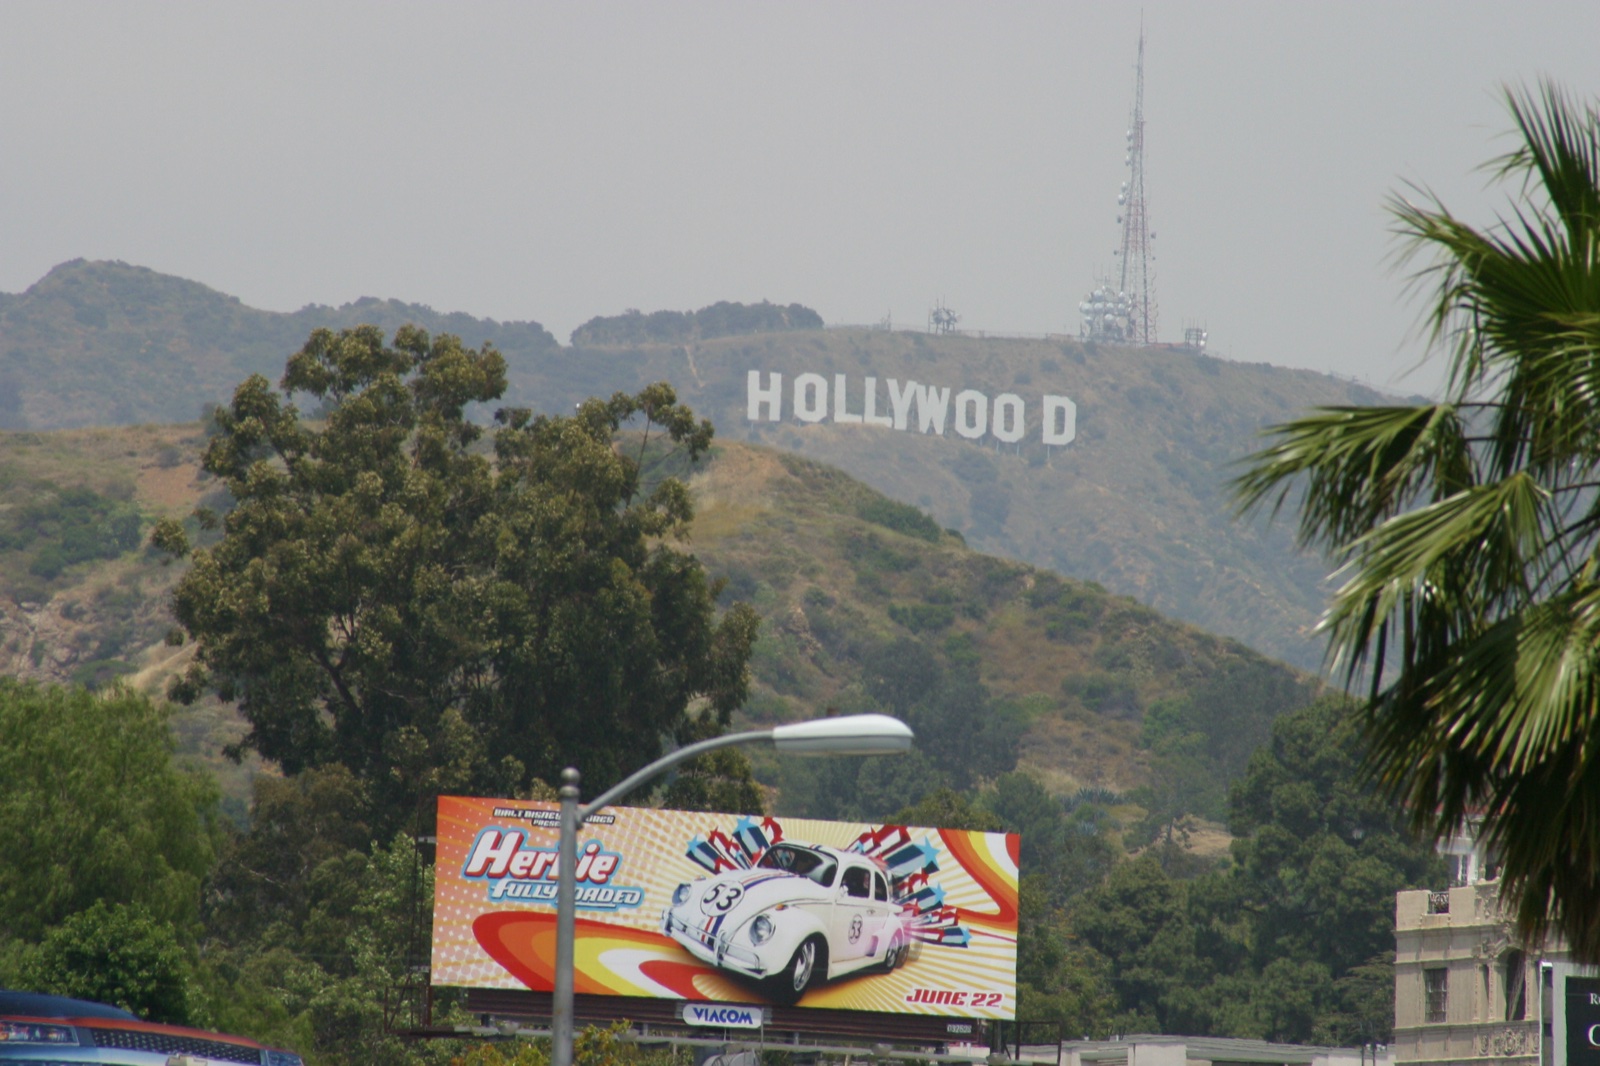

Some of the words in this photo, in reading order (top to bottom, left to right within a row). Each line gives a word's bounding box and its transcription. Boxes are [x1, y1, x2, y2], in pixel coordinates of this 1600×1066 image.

[747, 370, 1077, 446] HOLLYWOOD
[566, 886, 642, 908] OADED
[703, 883, 741, 911] 53
[850, 919, 863, 940] 53
[906, 989, 968, 1006] JUNE
[970, 993, 1003, 1008] 22
[692, 1007, 754, 1025] VIACOM
